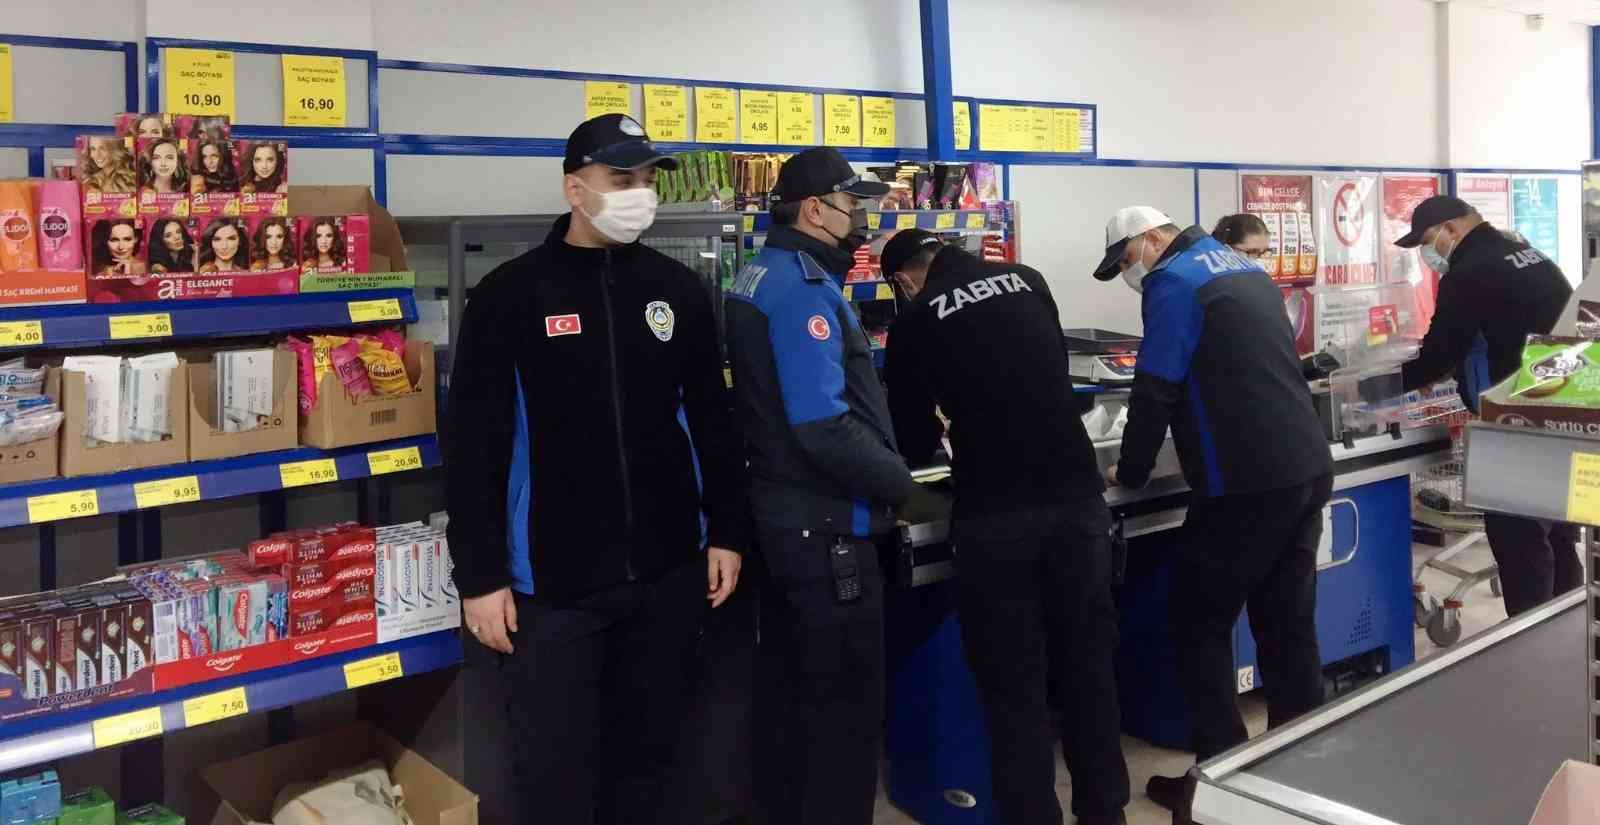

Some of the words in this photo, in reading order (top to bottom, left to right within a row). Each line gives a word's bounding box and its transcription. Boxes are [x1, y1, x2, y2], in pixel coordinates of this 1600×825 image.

[183, 94, 222, 108] 10,90
[299, 98, 335, 111] 16,90
[751, 122, 769, 132] 4,95
[187, 278, 233, 289] ELEGANCE
[929, 271, 1033, 321] ZABITA
[147, 324, 169, 334] 3,00
[15, 331, 40, 343] 4,00
[310, 469, 336, 480] 16,90
[173, 487, 198, 498] 9,95
[70, 501, 95, 513] 5,90
[337, 544, 375, 556] Colgate
[292, 585, 333, 600] Colgate
[239, 593, 249, 630] Colgate
[379, 664, 399, 677] 3,50
[39, 685, 114, 706] Powerdent
[222, 700, 244, 713] 7,50
